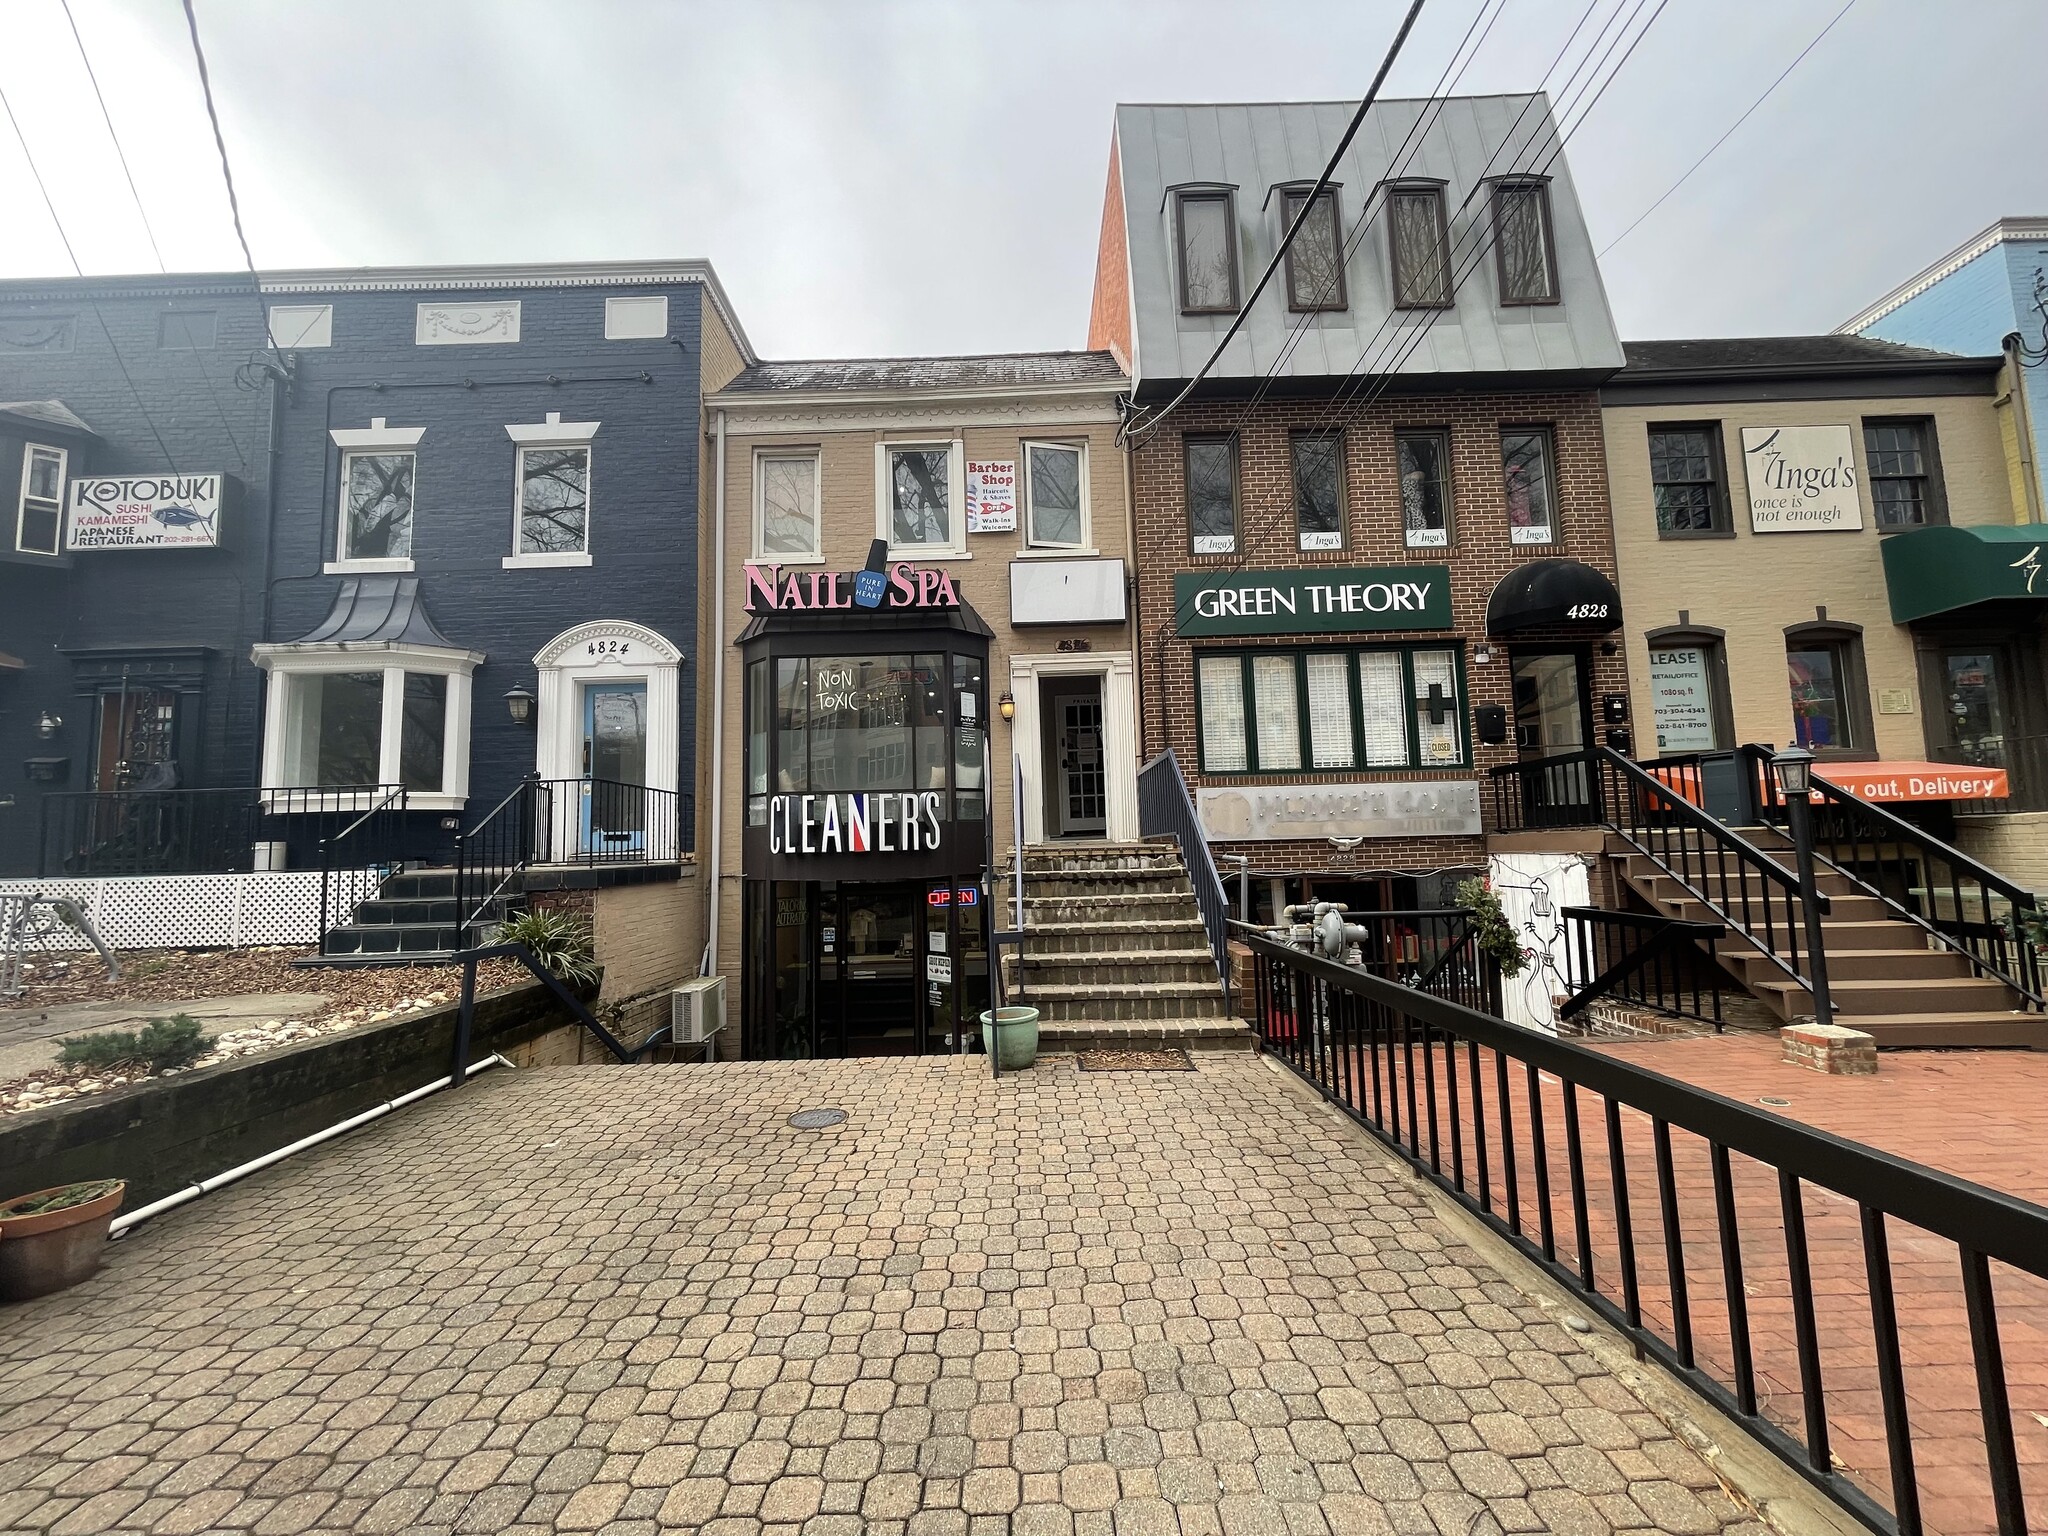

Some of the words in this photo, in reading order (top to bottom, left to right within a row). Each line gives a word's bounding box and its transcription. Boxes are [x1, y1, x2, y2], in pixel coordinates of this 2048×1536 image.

[968, 463, 1014, 473] Barber
[981, 474, 1014, 486] Shop
[1773, 456, 1855, 498] Inga's
[77, 477, 214, 515] KOTOBUKI
[1753, 498, 1787, 509] once
[1791, 494, 1803, 508] is
[116, 504, 152, 514] SUSHI
[1756, 509, 1781, 522] not
[1785, 505, 1842, 525] enough
[77, 515, 148, 526] KAMAMESHI
[79, 535, 164, 546] RESTAURANT
[1421, 532, 1445, 544] Inga's
[1525, 529, 1550, 541] Inga's
[1315, 535, 1341, 549] Inga's
[742, 563, 851, 611] NAIL
[889, 561, 960, 608] SPA
[860, 577, 882, 588] PURE
[855, 589, 883, 600] HEART
[1194, 586, 1297, 618] GREEN
[1304, 582, 1432, 614] THEORY
[1567, 603, 1608, 619] 4828
[588, 640, 630, 655] 4824
[1650, 652, 1697, 665] LEASE
[1652, 672, 1699, 680] RETAIL/OFFICE
[1660, 688, 1677, 696] 1080
[1688, 687, 1694, 695] ft
[1431, 743, 1451, 752] CLOSED
[1864, 783, 1904, 799] out,
[1909, 777, 1996, 798] Delivery
[770, 791, 941, 855] CLEANERS
